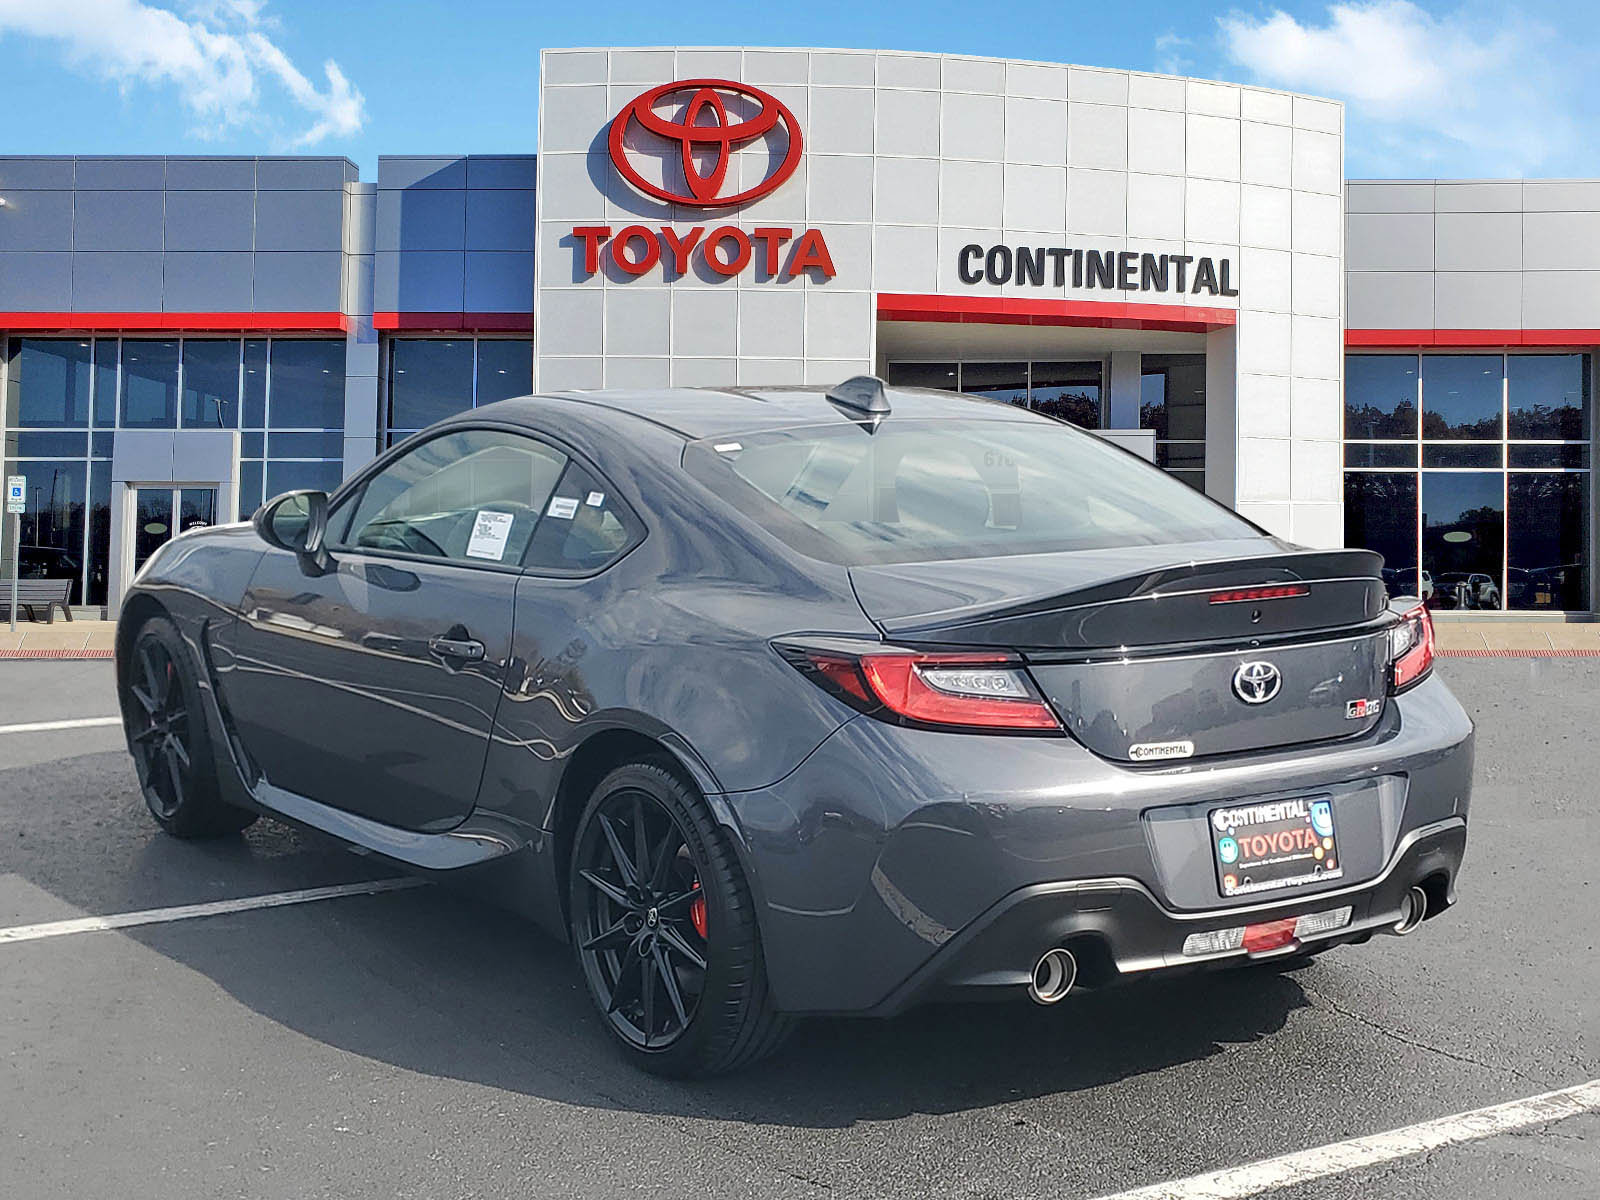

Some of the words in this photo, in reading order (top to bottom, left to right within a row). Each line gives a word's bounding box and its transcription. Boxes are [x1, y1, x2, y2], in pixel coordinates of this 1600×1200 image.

[572, 225, 837, 277] TOYOTA
[959, 244, 1239, 297] CONTINENTAL
[1136, 745, 1187, 758] CONTINENTAL
[1213, 800, 1309, 832] CONTINENTAL
[1238, 828, 1318, 858] TOYOTA
